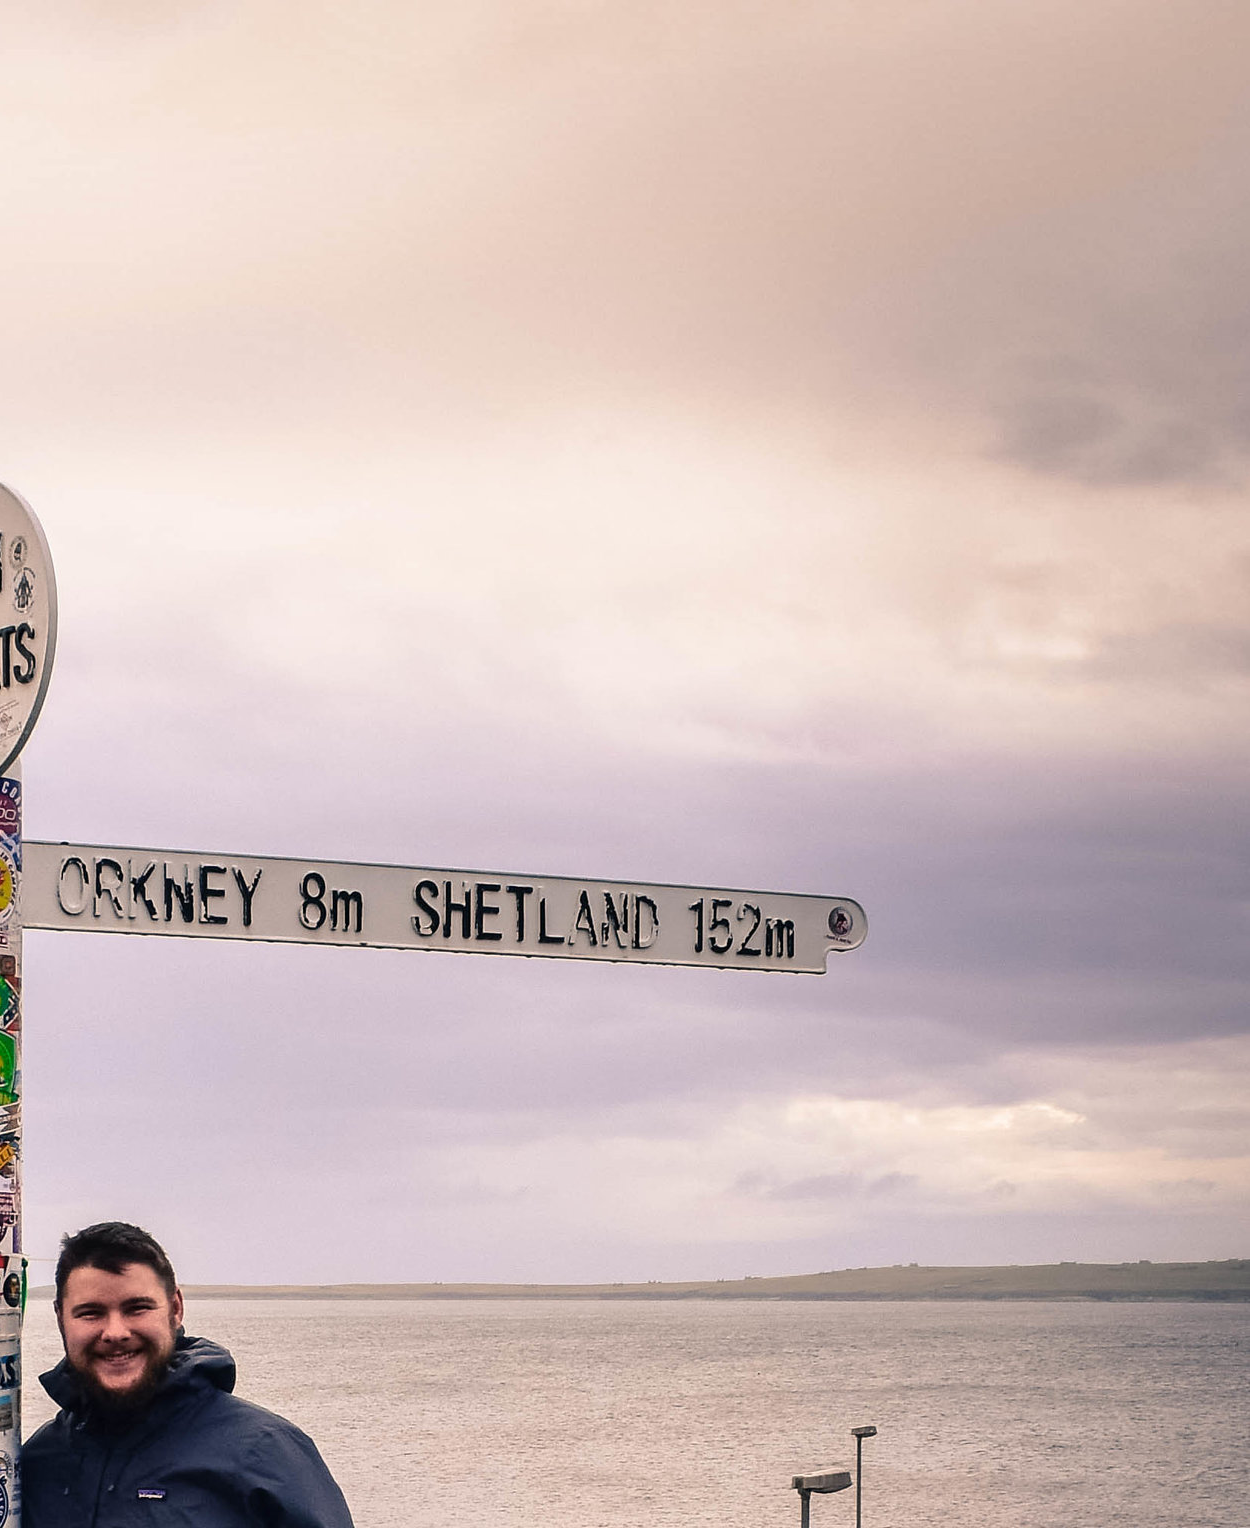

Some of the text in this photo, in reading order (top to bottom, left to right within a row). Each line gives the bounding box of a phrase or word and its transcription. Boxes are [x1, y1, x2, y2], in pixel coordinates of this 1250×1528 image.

[56, 855, 795, 959] ORKNEY 8m SHETLAND 152m
